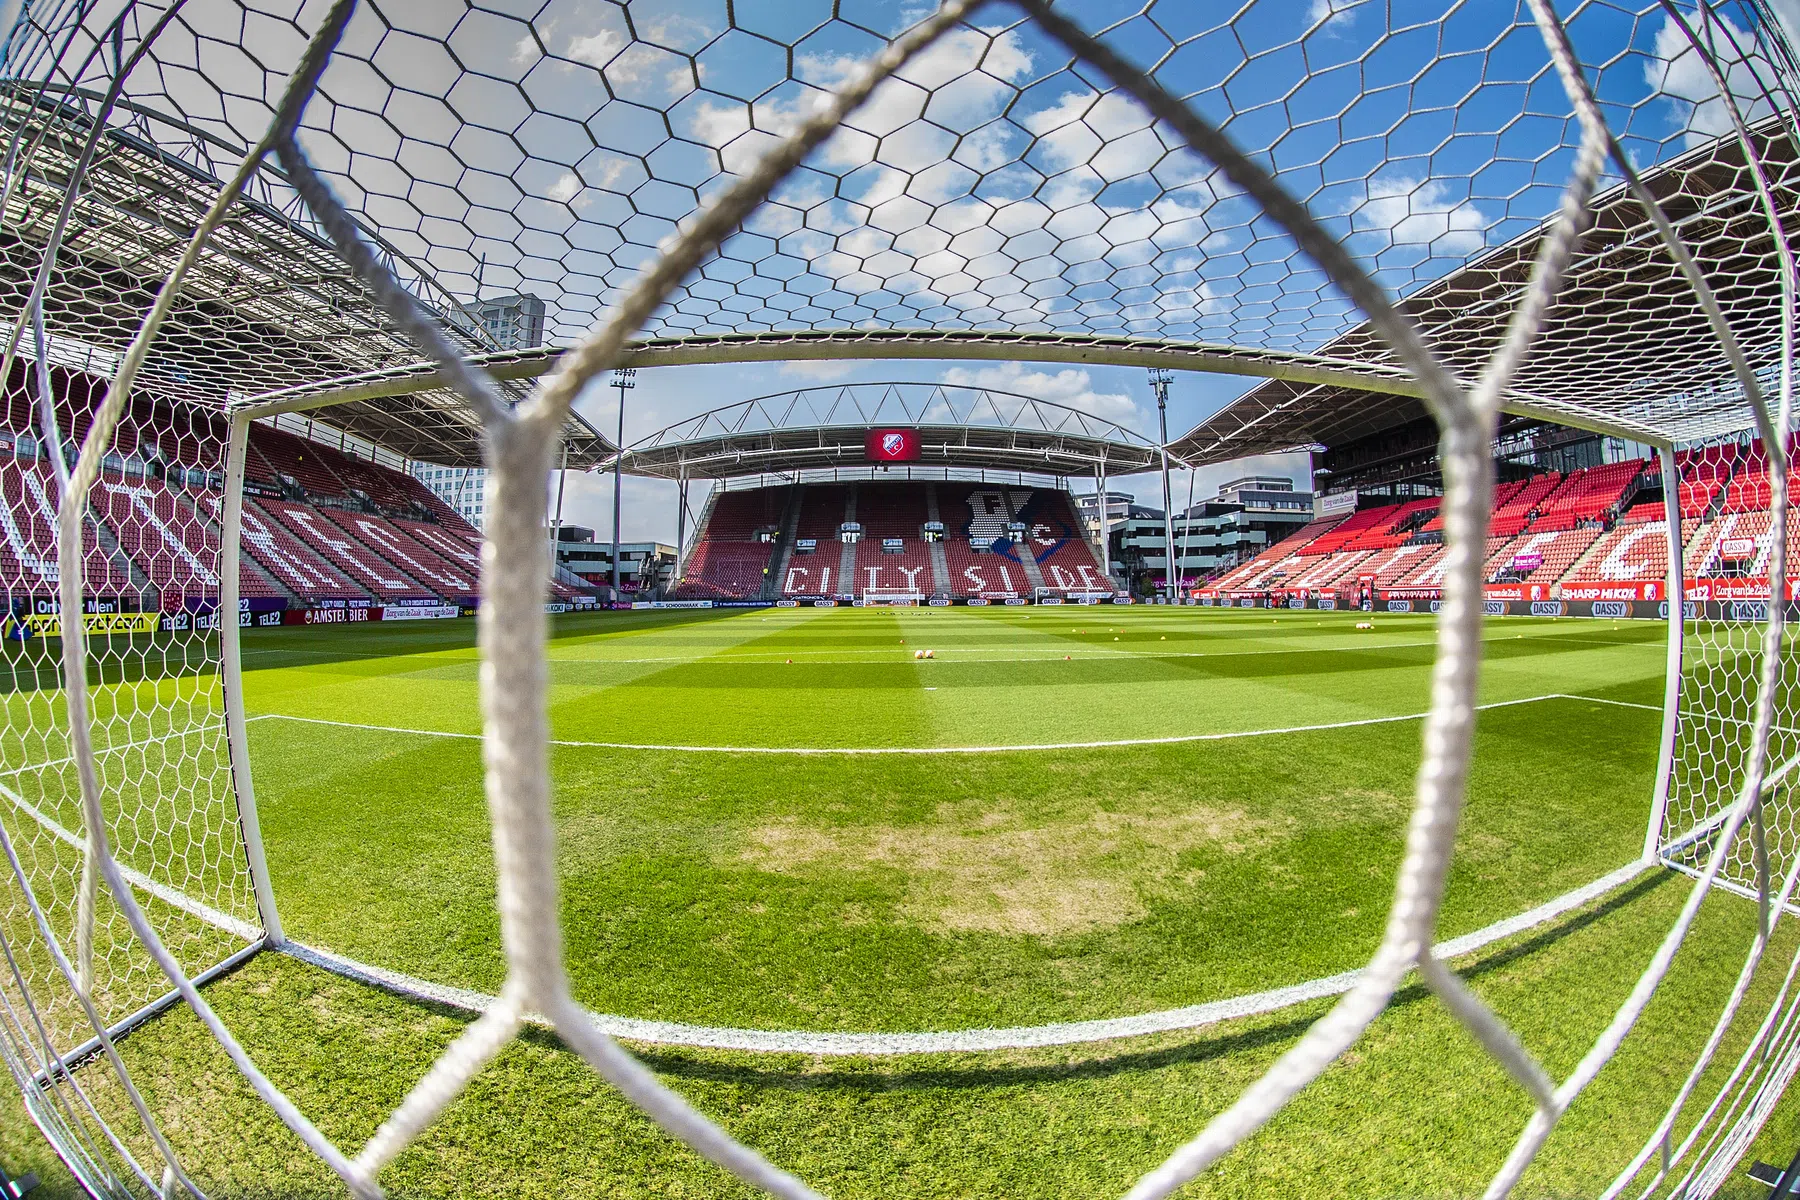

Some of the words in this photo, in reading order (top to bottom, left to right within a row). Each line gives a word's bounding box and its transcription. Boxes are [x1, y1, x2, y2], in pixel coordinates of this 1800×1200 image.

[0, 468, 486, 593] UTRECH
[783, 566, 924, 593] CITY
[963, 565, 1102, 592] SIDE
[1561, 588, 1600, 599] SHARP
[1290, 600, 1303, 608] DASSY
[1389, 601, 1408, 610] DASSY
[1533, 602, 1559, 614] DASSY
[1595, 602, 1624, 616] DASSY
[162, 613, 189, 631] TELE2
[259, 610, 280, 626] TELE2
[313, 609, 347, 624] AMSTEL
[349, 609, 369, 622] BIER
